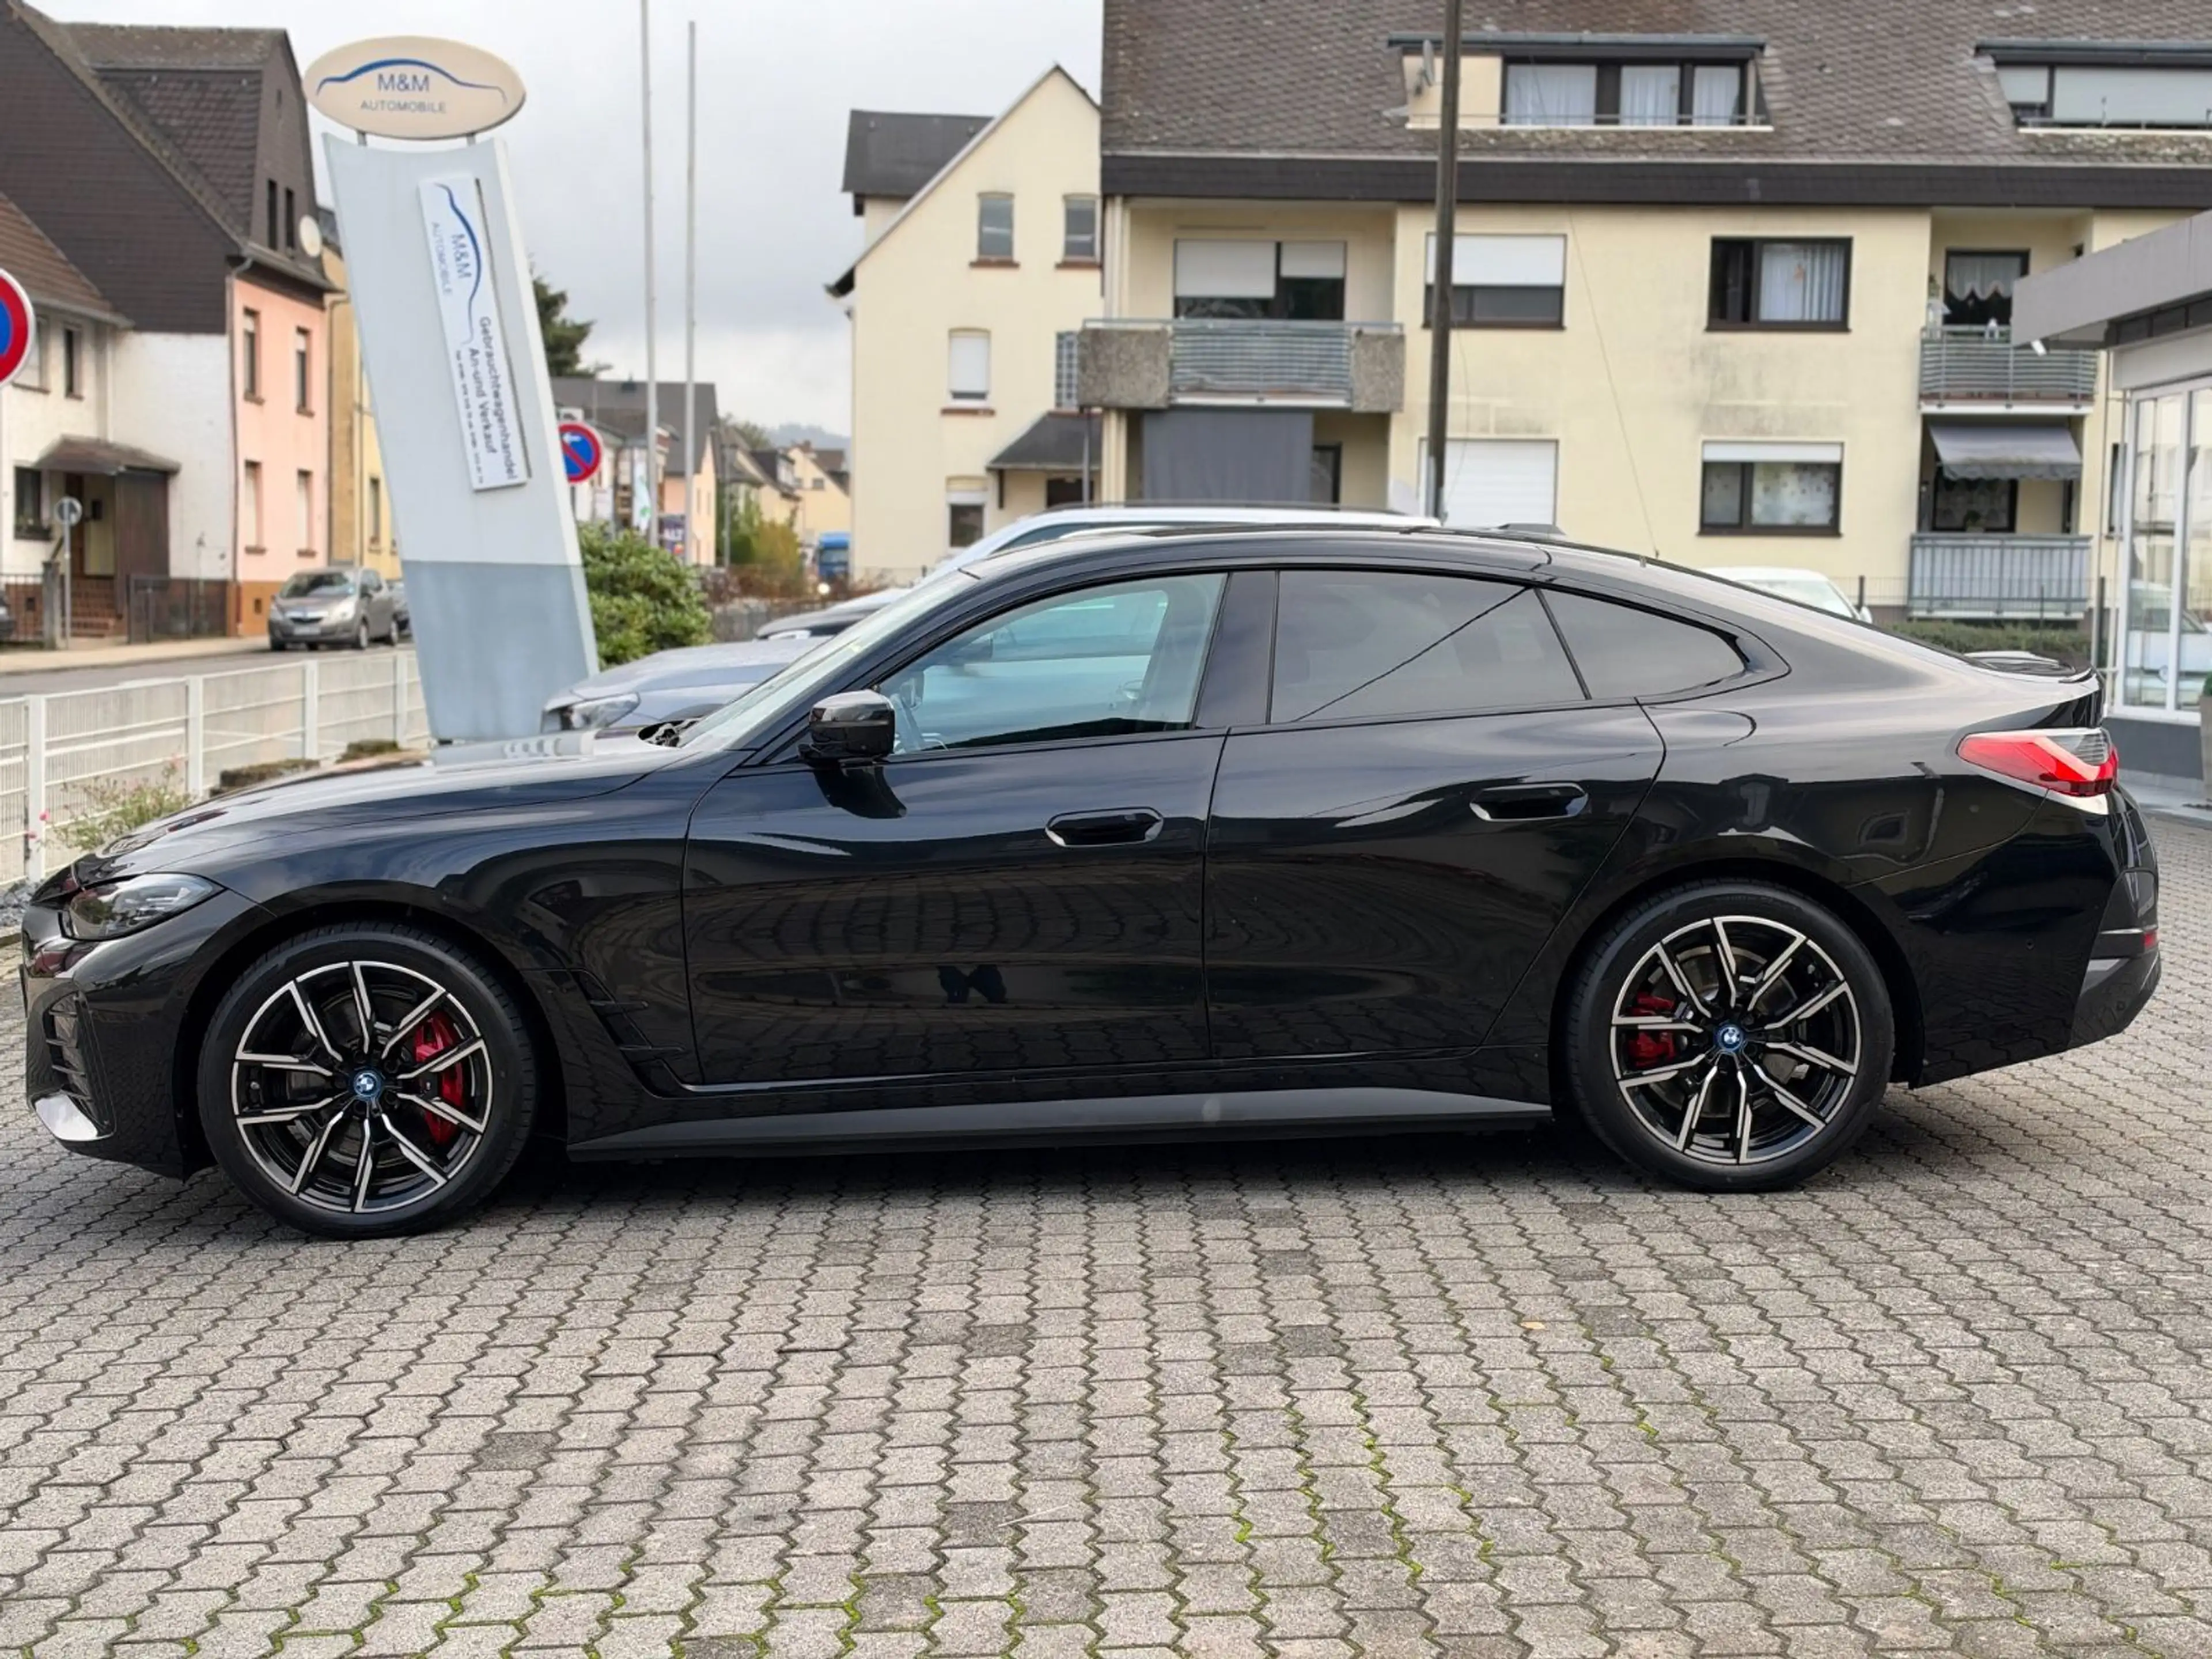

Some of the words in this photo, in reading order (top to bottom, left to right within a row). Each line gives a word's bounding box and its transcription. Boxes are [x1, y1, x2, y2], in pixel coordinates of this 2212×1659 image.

[361, 99, 446, 113] AUTOMOBILE
[378, 73, 430, 92] M&M
[432, 221, 452, 296] AUTOMOBILE
[450, 233, 472, 279] M&M
[479, 316, 518, 480] Gebrauchtwagenhandel
[479, 400, 498, 453] Verkauf
